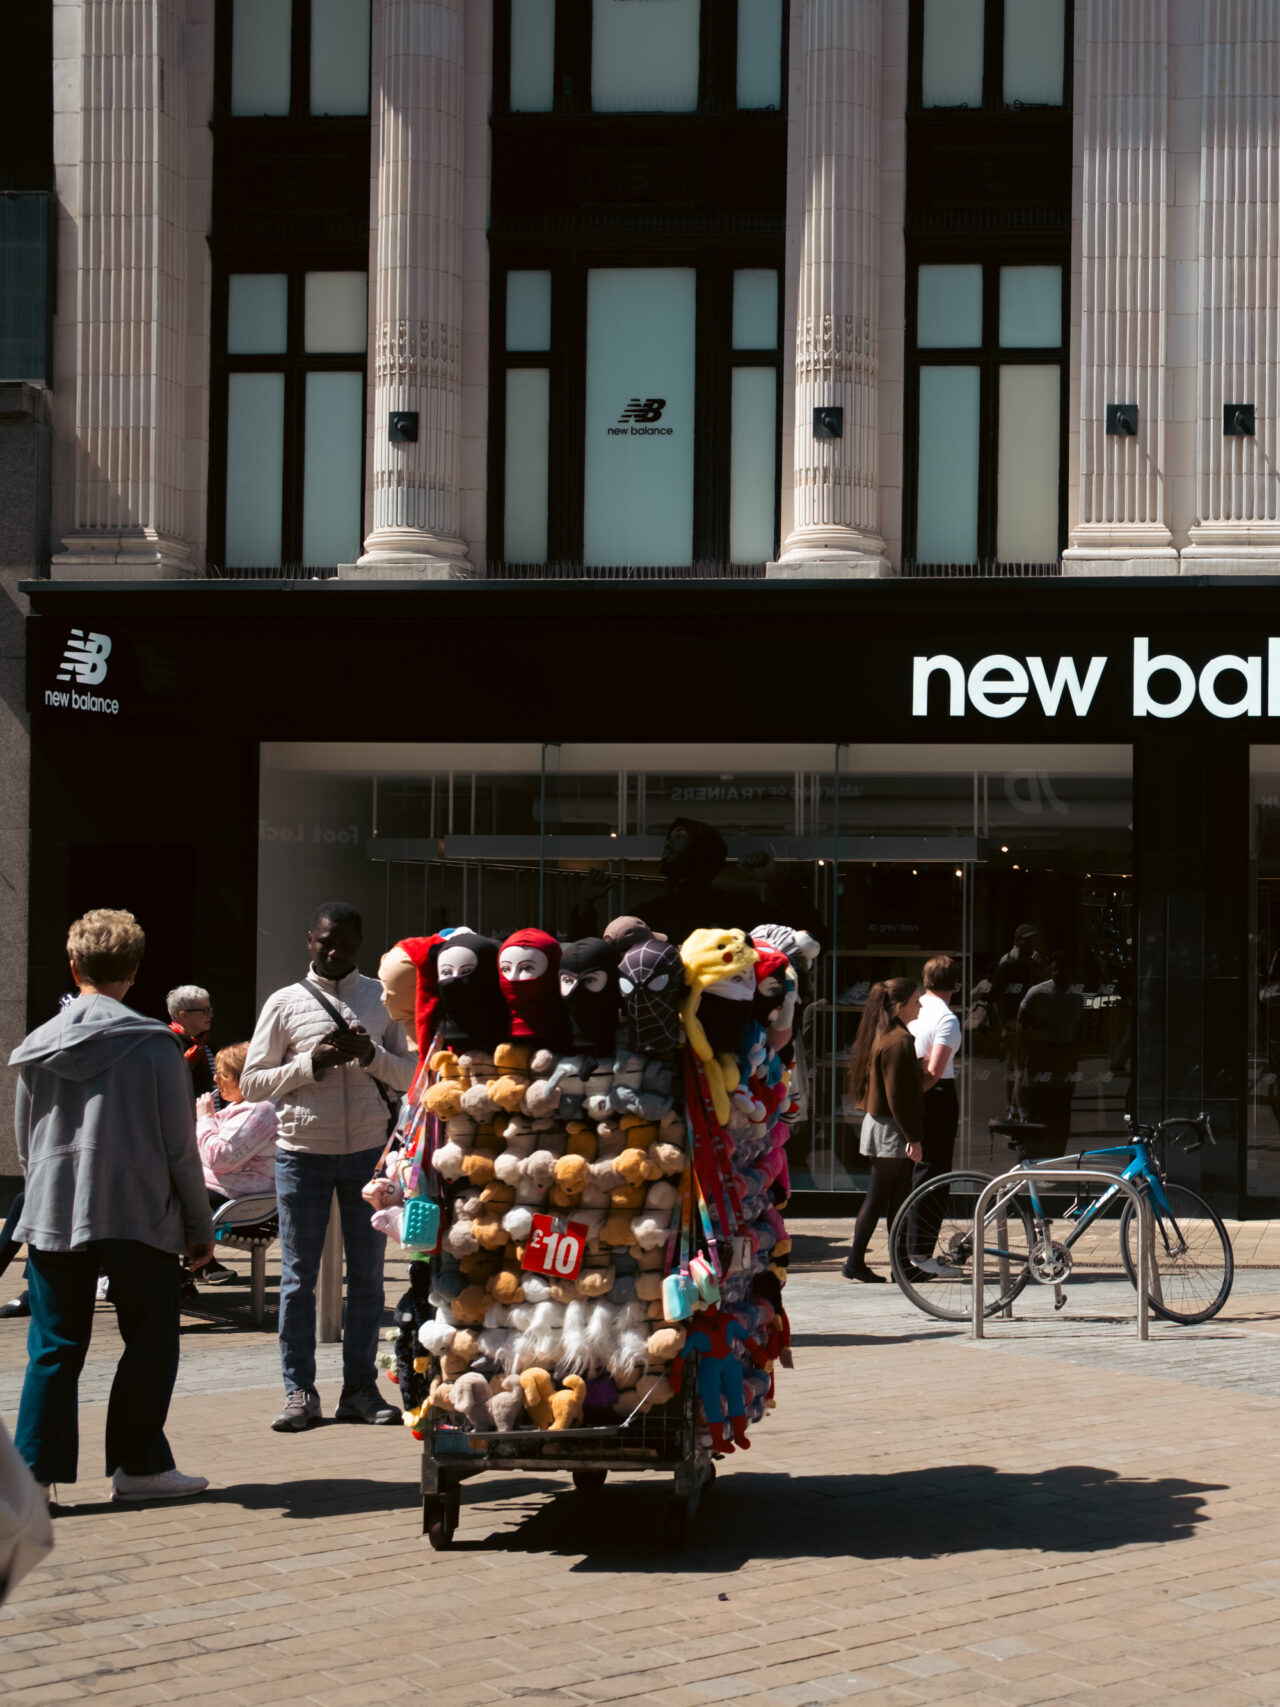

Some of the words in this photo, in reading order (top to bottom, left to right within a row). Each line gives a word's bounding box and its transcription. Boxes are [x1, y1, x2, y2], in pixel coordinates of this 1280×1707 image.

[607, 426, 628, 435] new
[630, 426, 673, 435] balance
[45, 690, 70, 708] new
[71, 690, 119, 715] balance
[911, 654, 1108, 719] new
[530, 1229, 579, 1275] £10
